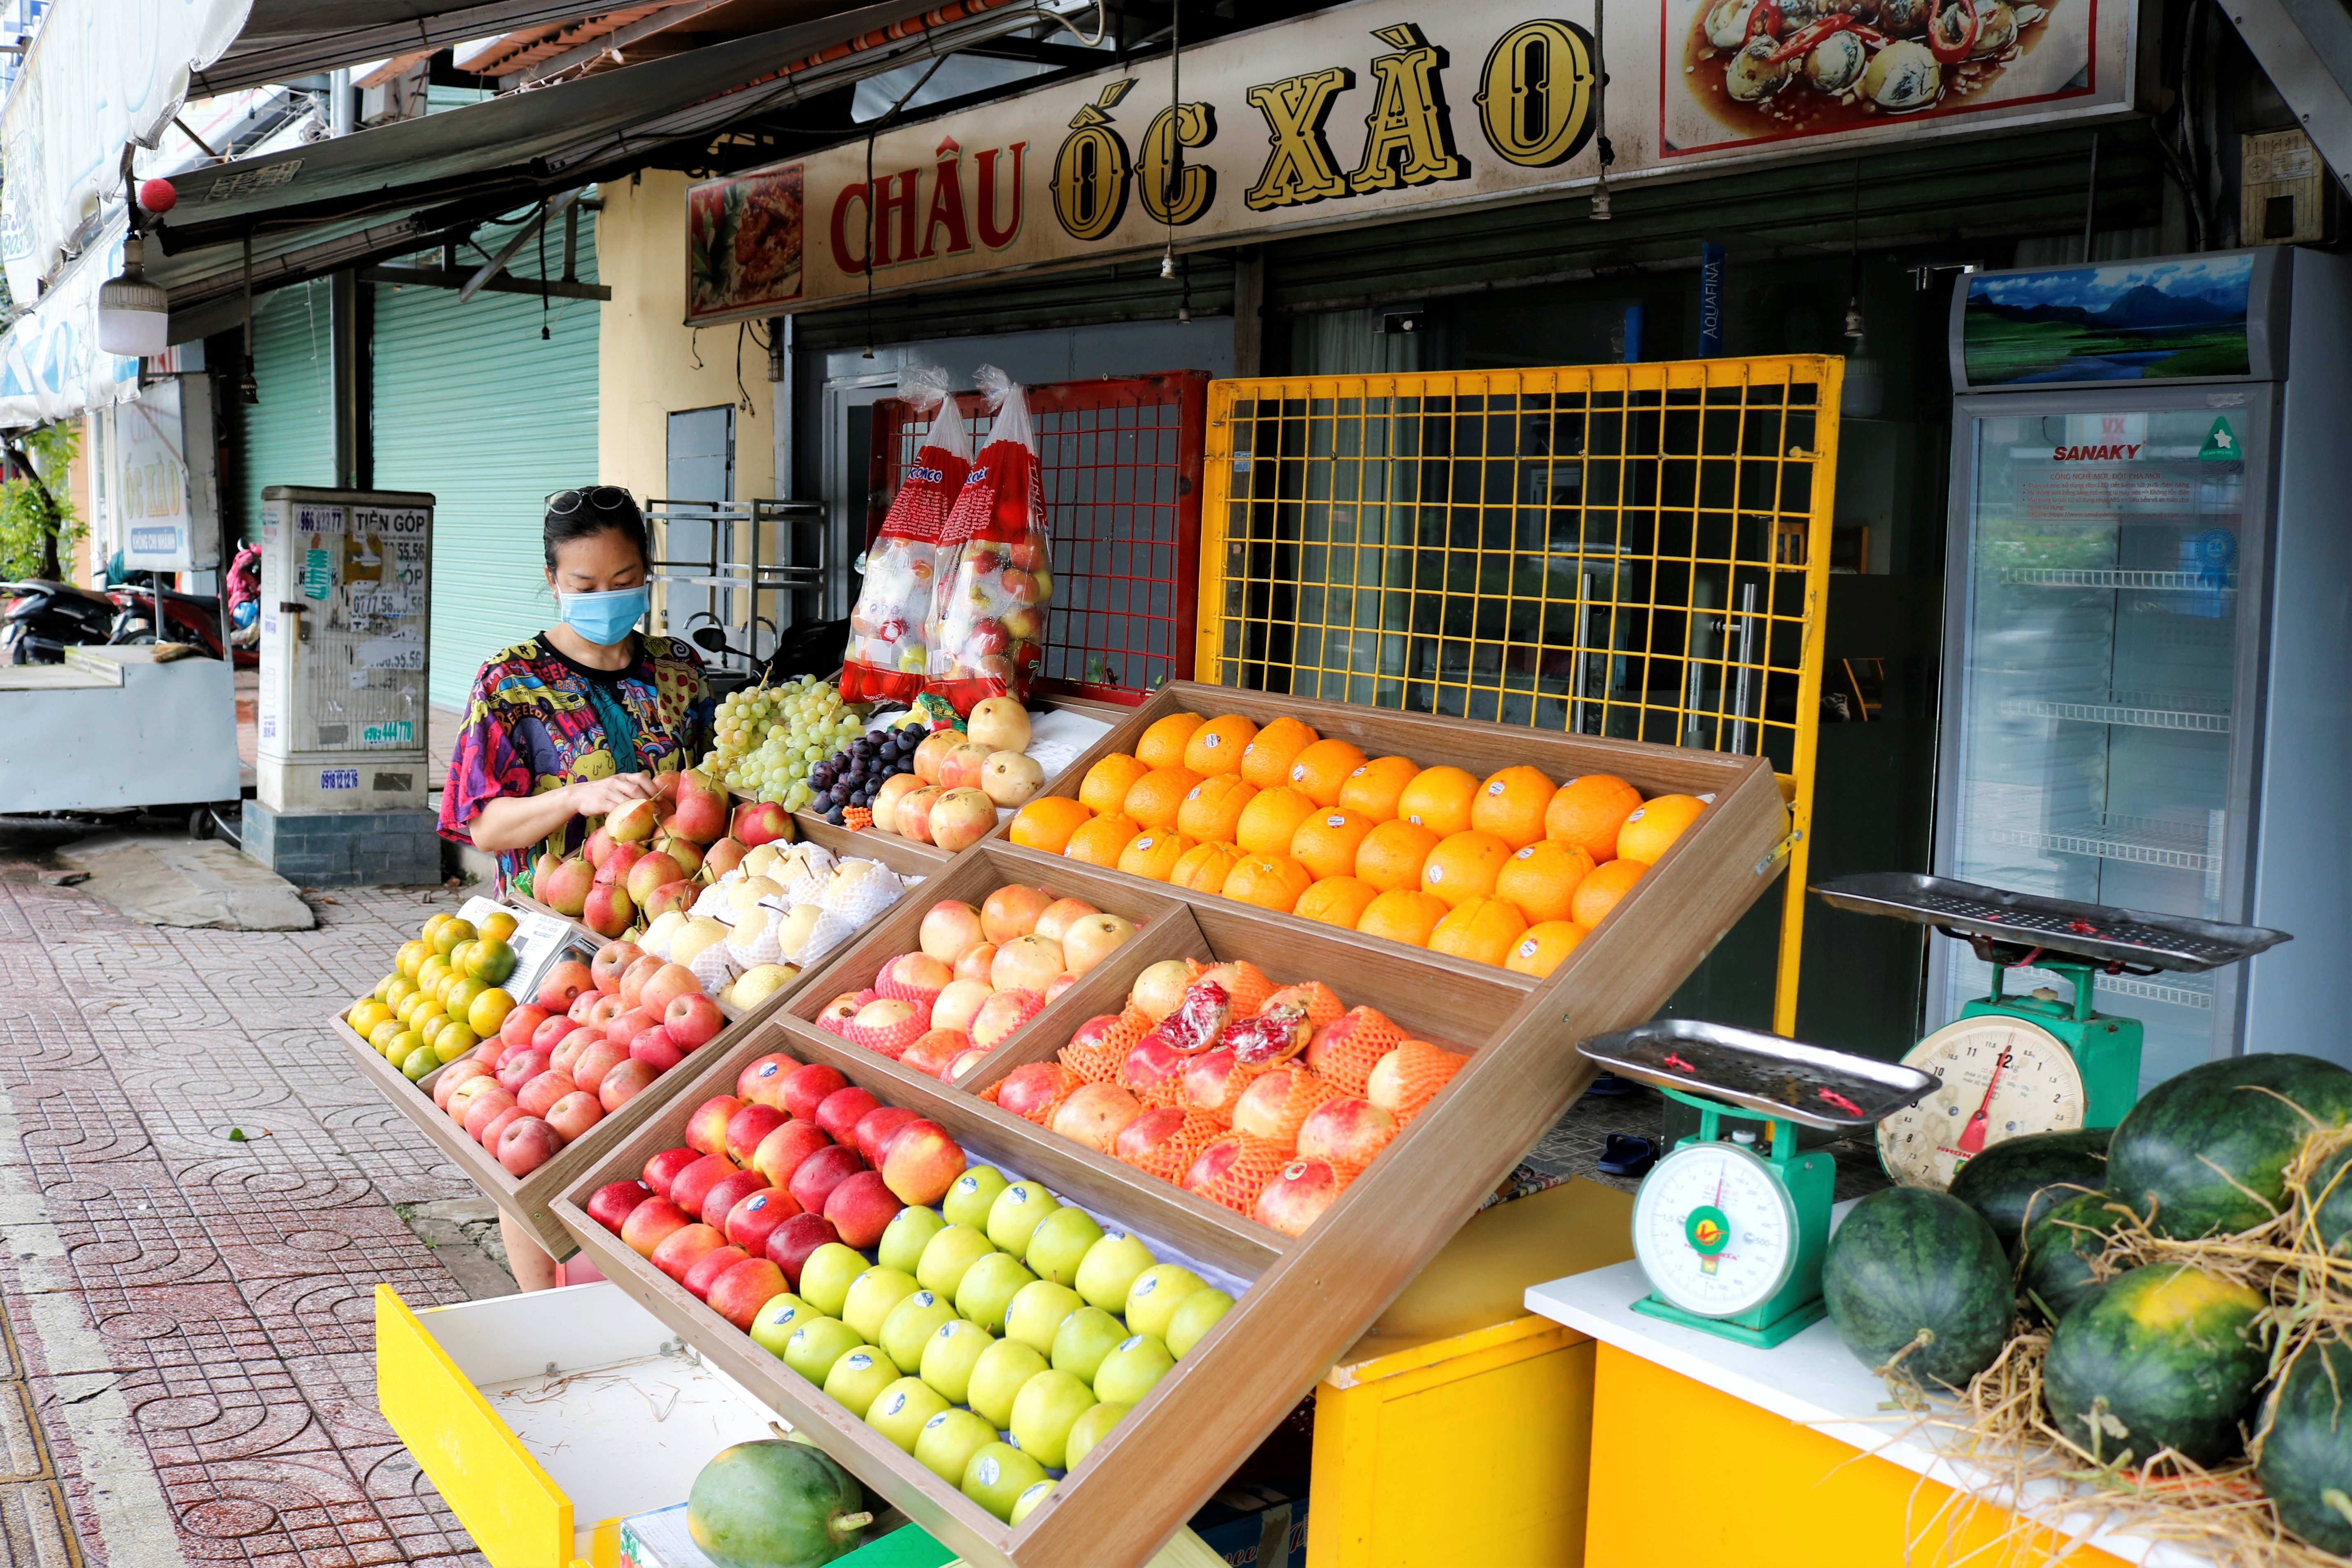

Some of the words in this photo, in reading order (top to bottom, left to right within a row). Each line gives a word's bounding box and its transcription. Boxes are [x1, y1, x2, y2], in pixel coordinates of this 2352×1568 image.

[830, 134, 1030, 278] CHÂU
[1049, 79, 1218, 241] ỐC
[1244, 18, 1609, 212] XÀO
[1703, 260, 1720, 340] AQUAFINA
[2053, 444, 2141, 461] SANAKY
[124, 453, 143, 519] ỐC
[146, 452, 180, 518] XÀO
[394, 511, 425, 532] GÓP
[148, 534, 157, 550] CHI
[1967, 1047, 1977, 1057] 11
[1995, 1053, 2013, 1069] 12
[2009, 1062, 2020, 1073] kg
[2037, 1062, 2042, 1071] 1
[1934, 1066, 1945, 1076] 10
[2053, 1093, 2061, 1103] 2
[1906, 1133, 1913, 1143] 8
[1921, 1165, 1929, 1175] 7
[1755, 1237, 1770, 1247] 500
